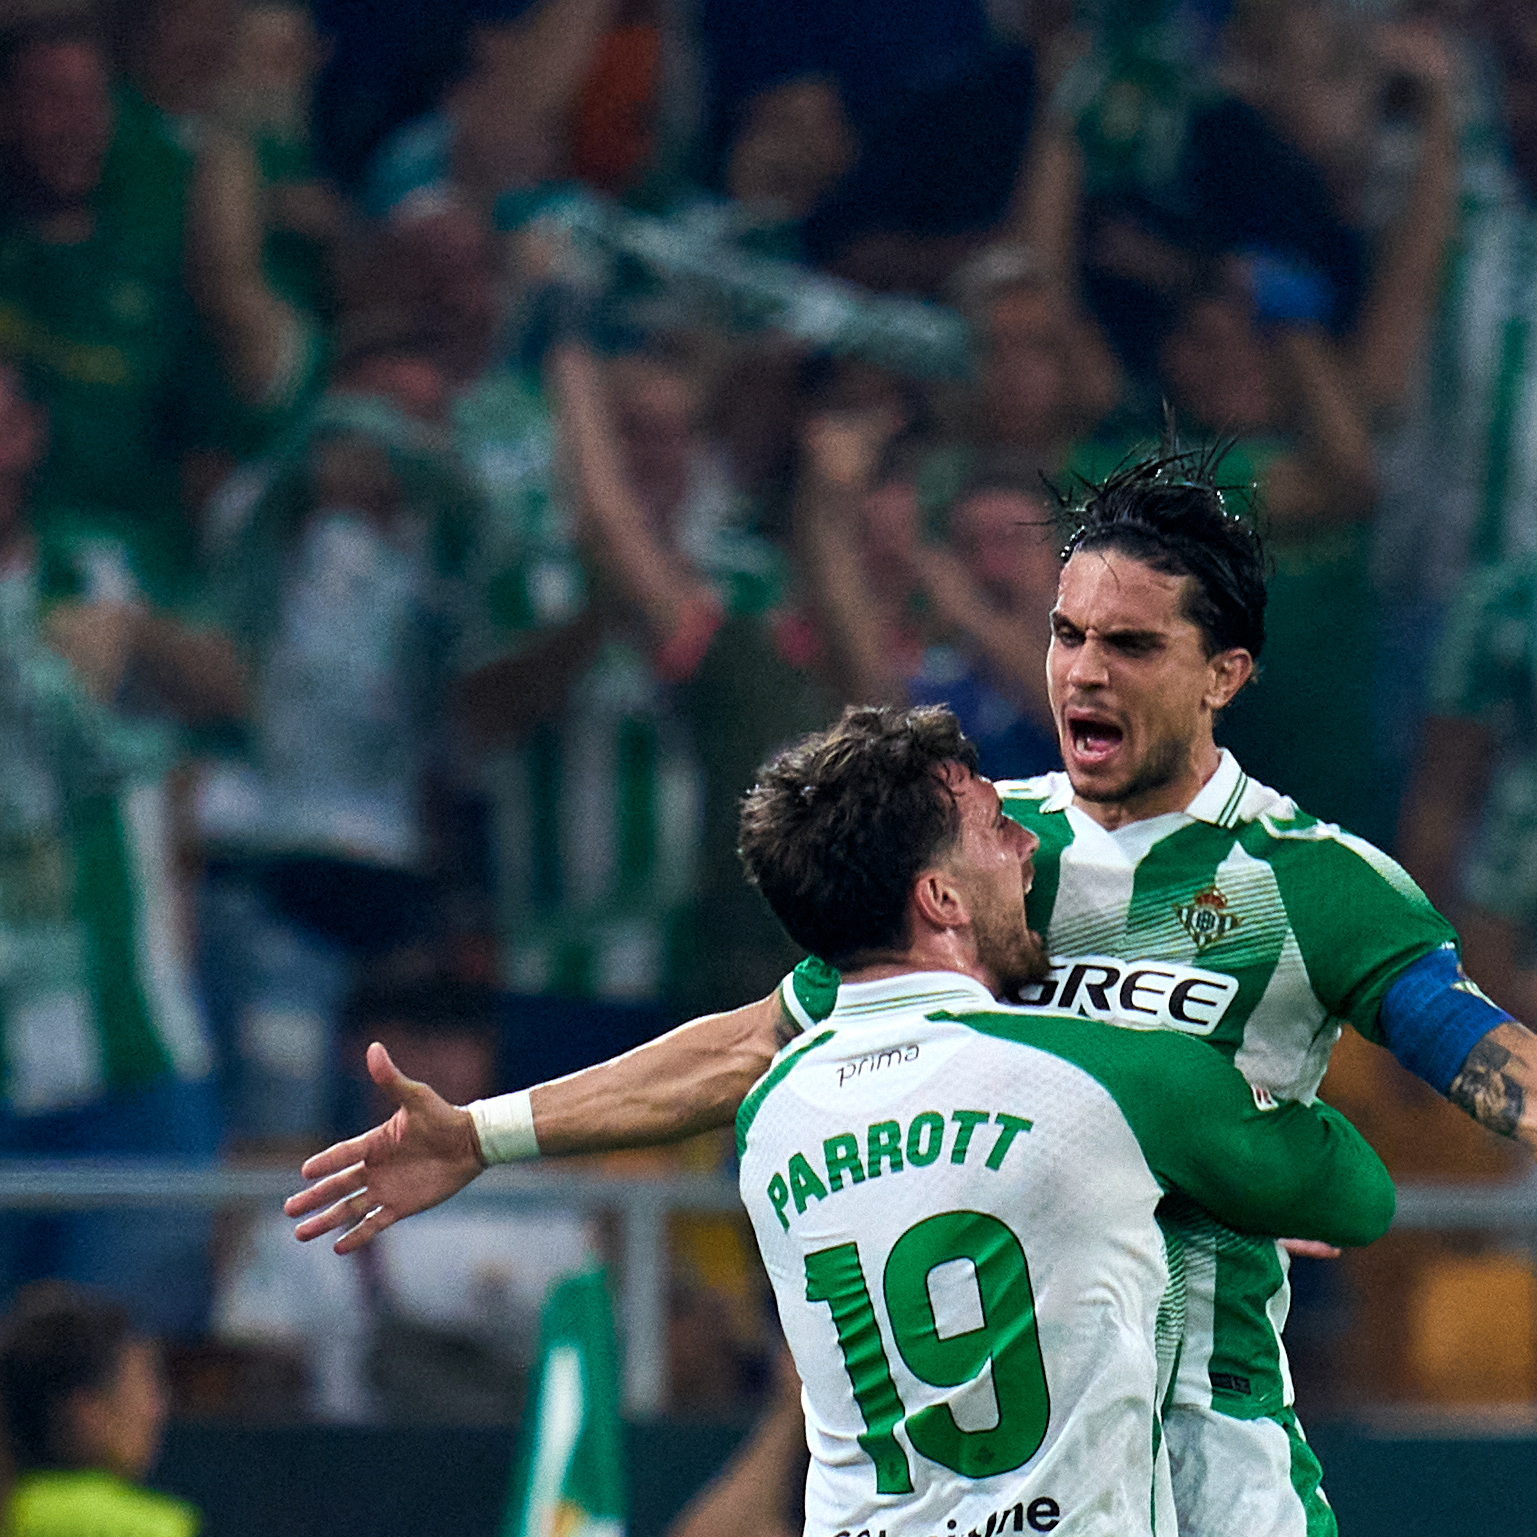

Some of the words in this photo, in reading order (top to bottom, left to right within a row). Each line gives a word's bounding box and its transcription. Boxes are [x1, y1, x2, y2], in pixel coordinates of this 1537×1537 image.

[836, 1043, 920, 1088] prima
[766, 1109, 1034, 1234] PARROTT
[804, 1208, 1051, 1495] 19
